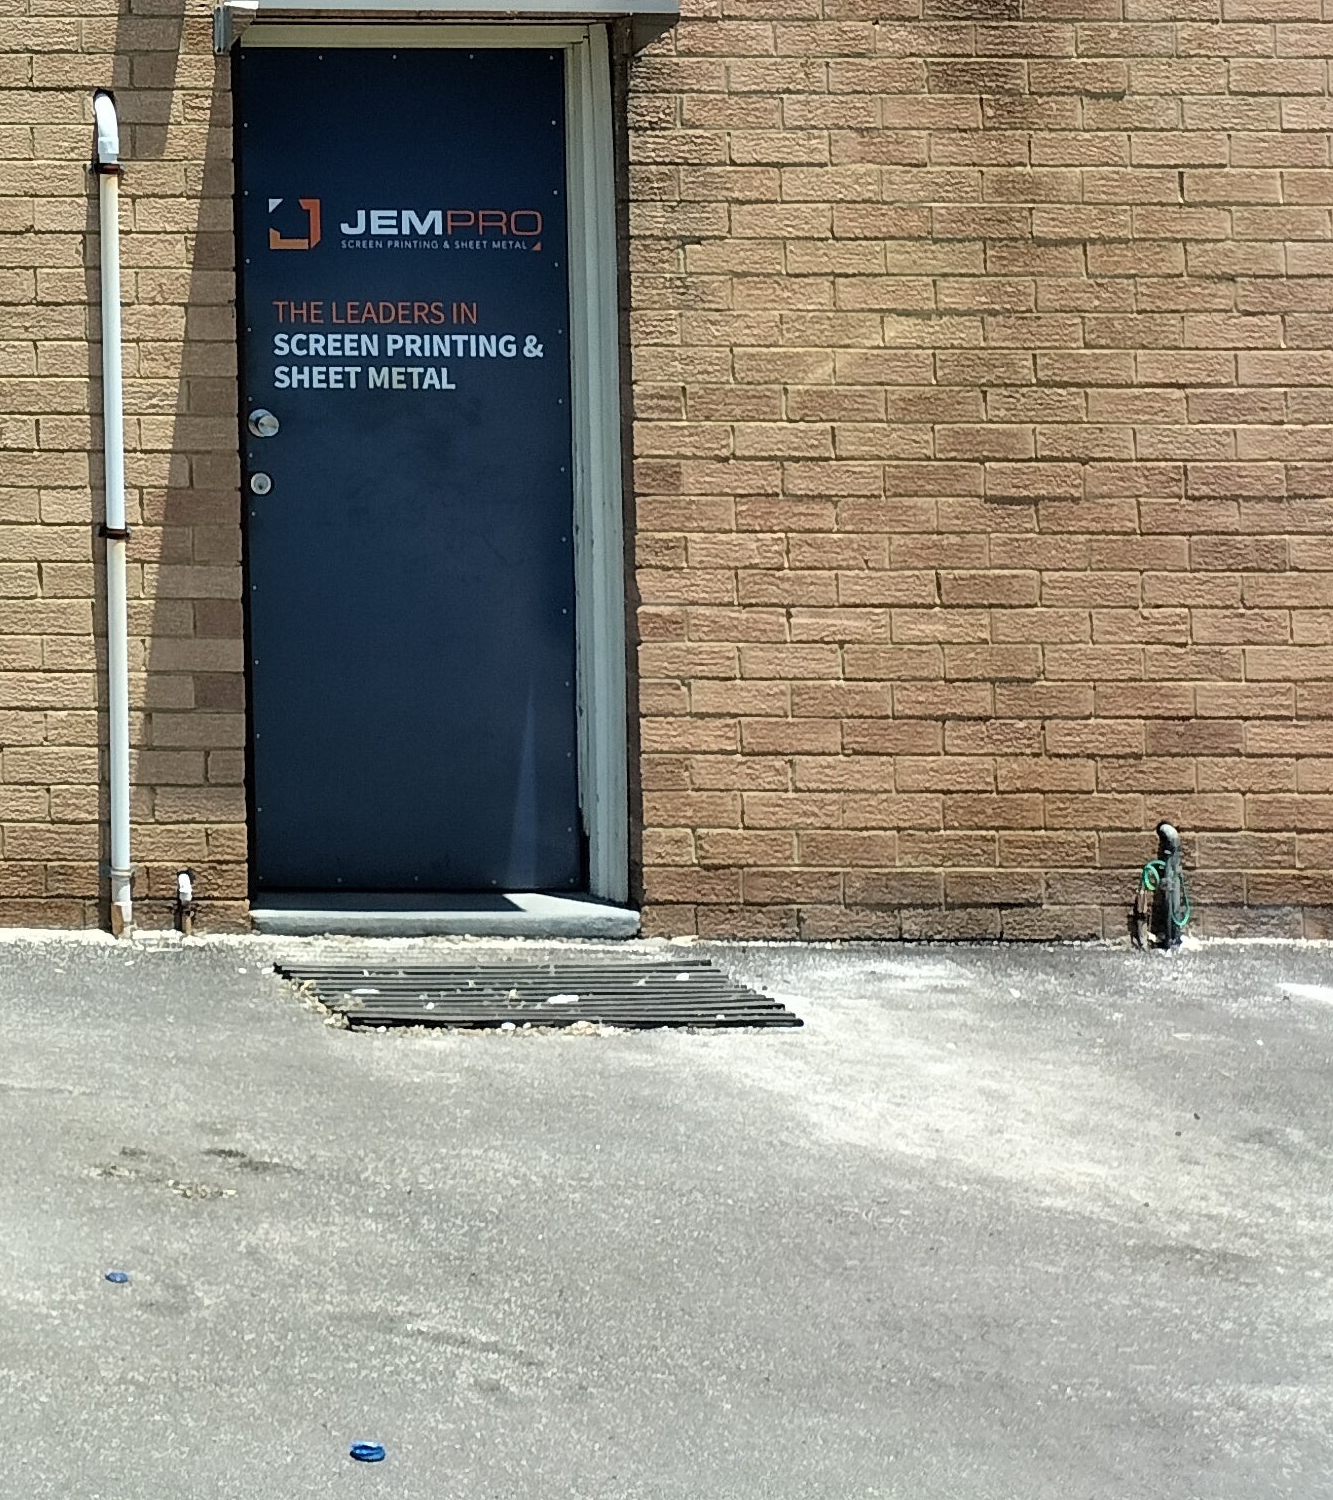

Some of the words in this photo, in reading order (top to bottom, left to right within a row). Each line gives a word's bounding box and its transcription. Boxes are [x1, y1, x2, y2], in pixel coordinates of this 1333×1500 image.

[340, 209, 543, 236] JEMPRO
[341, 240, 382, 248] SCREEN
[388, 240, 438, 249] PRINTING
[455, 241, 487, 249] SHEET
[492, 241, 526, 249] METAL
[273, 301, 324, 323] THE
[332, 302, 445, 324] LEADERS
[453, 303, 476, 324] IN
[274, 334, 378, 356] SCREEN
[387, 335, 516, 357] PRINTING
[523, 335, 543, 357] &
[275, 366, 361, 388] SHEET
[369, 367, 455, 389] METAL
